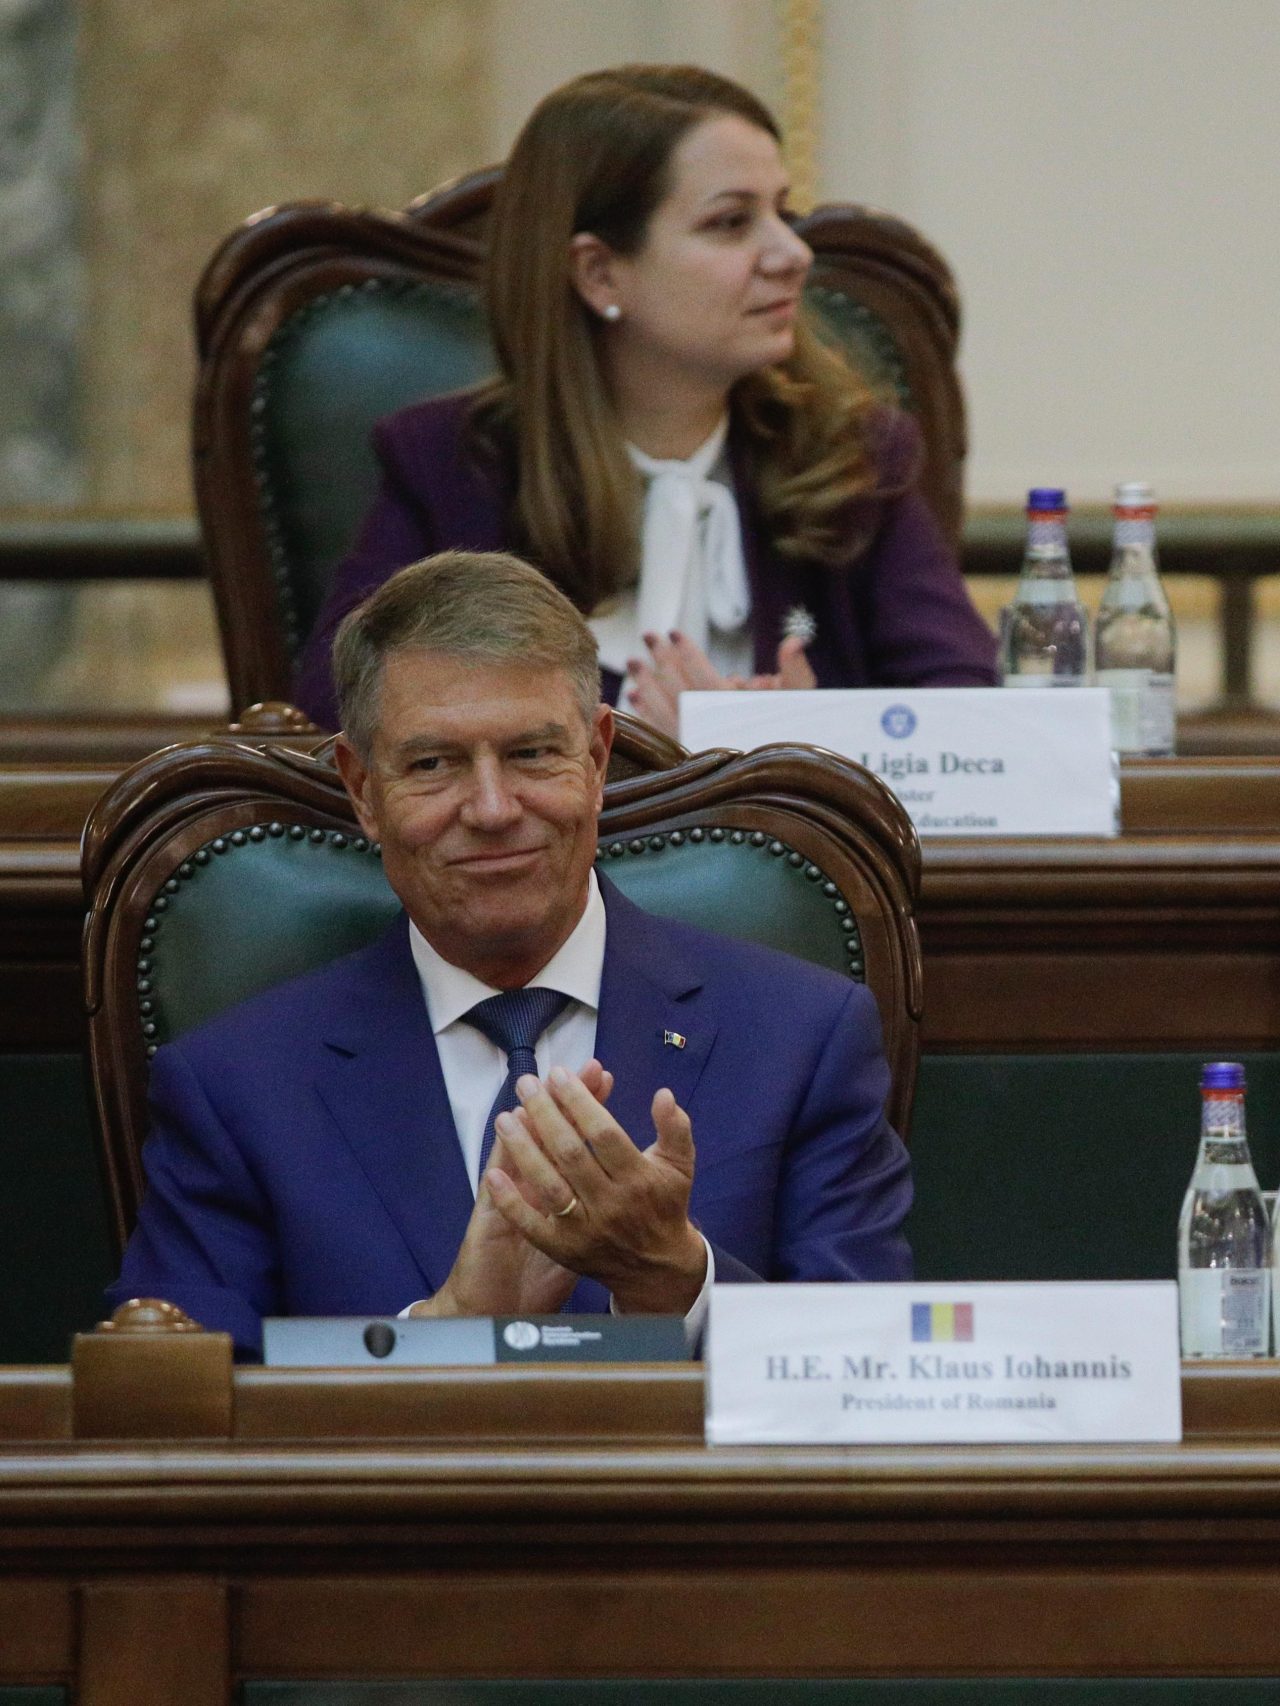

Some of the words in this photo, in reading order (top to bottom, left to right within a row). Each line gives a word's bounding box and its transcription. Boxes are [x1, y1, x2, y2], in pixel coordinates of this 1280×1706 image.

[939, 751, 1006, 774] Deca
[766, 1355, 832, 1381] H.E.
[843, 1355, 897, 1380] Mr.
[908, 1355, 993, 1380] Klaus
[1004, 1353, 1133, 1380] Iohannis
[840, 1393, 934, 1411] President
[942, 1392, 963, 1411] of
[967, 1391, 1058, 1411] Romania
